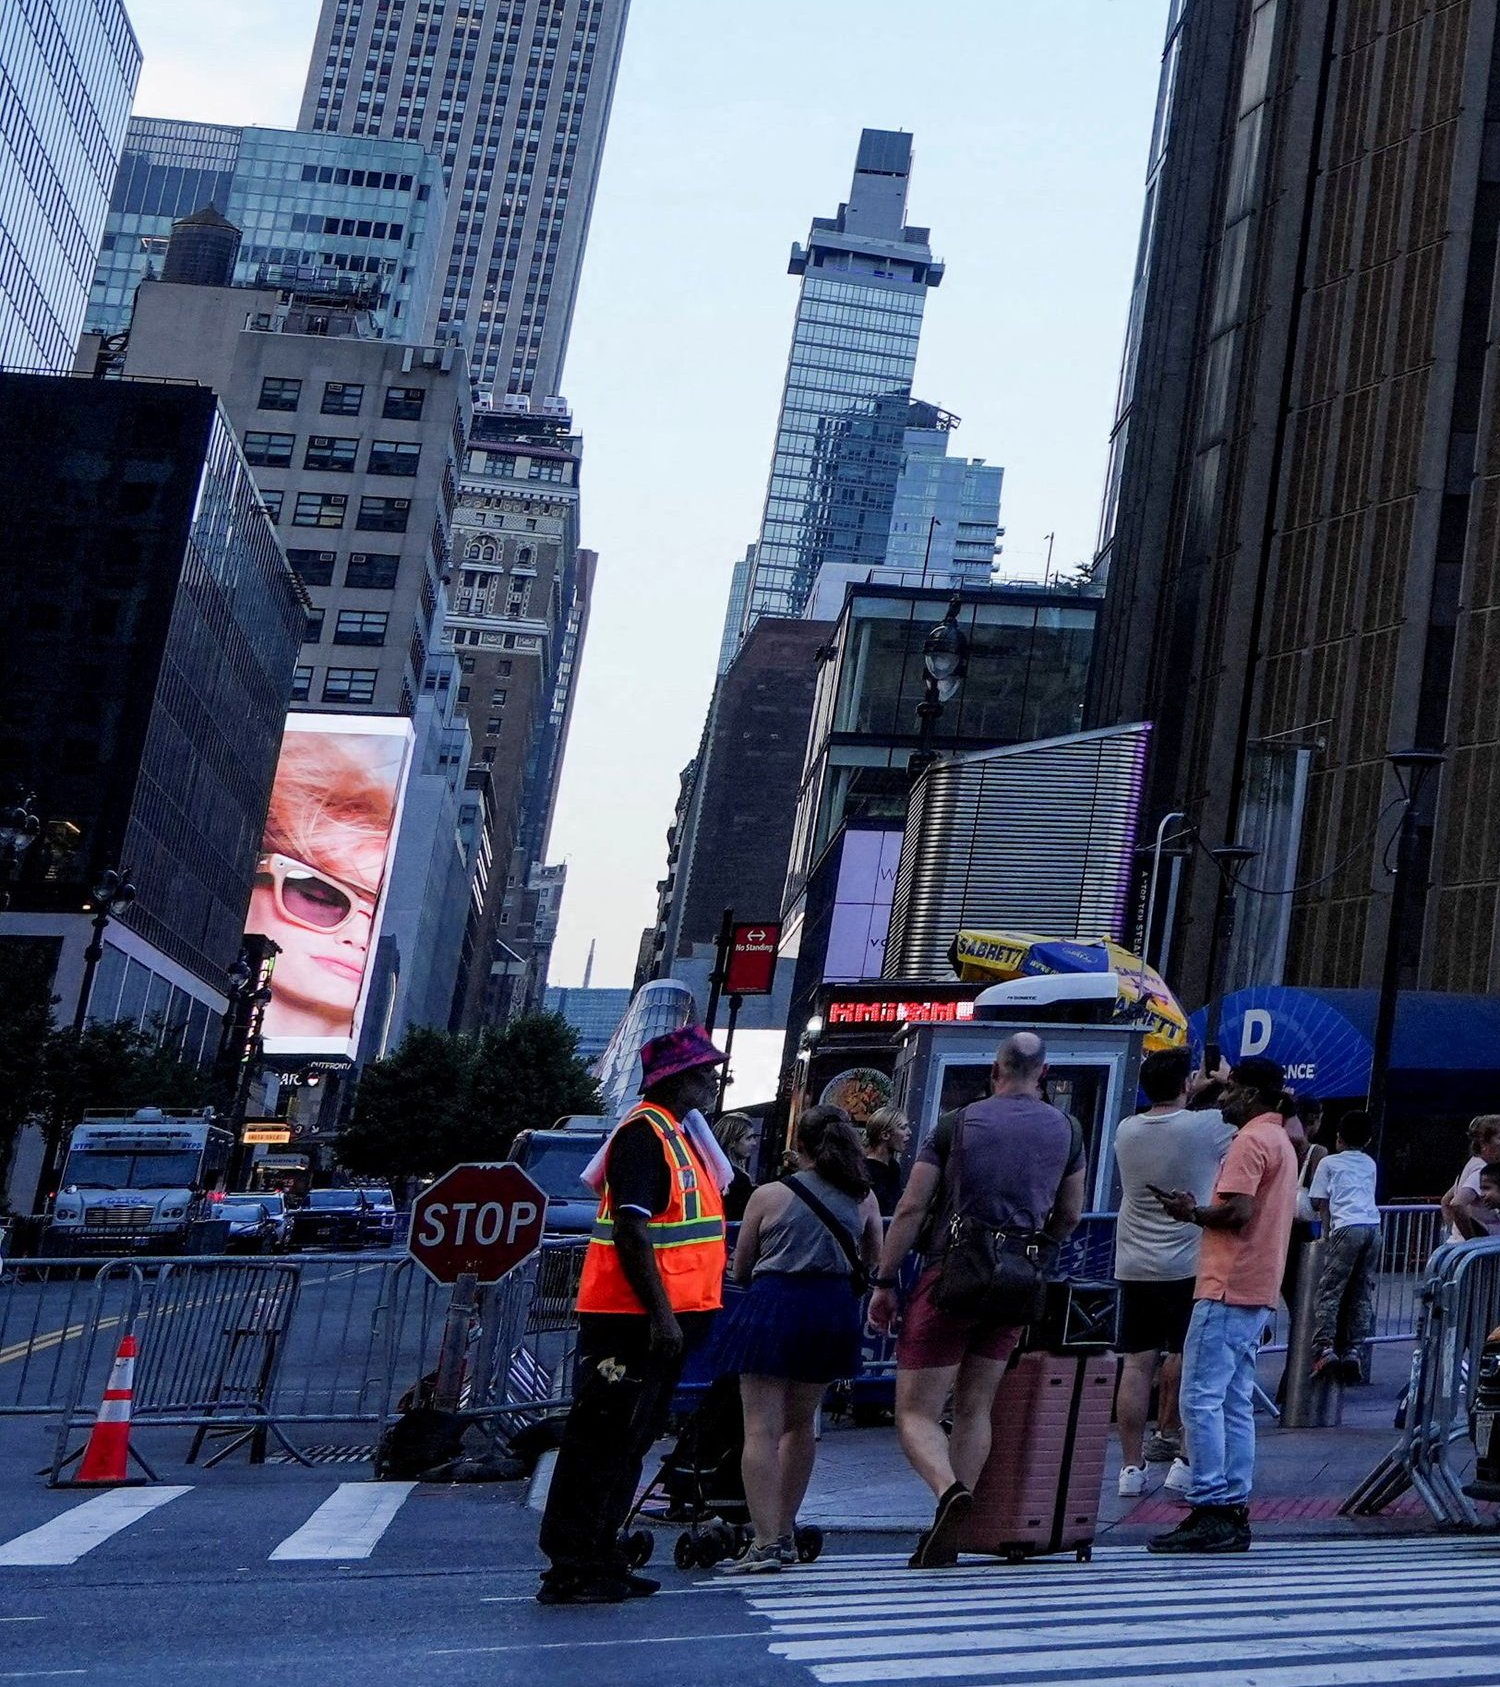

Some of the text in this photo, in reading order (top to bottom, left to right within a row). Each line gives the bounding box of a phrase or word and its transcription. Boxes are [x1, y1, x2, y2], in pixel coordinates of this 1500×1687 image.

[735, 943, 773, 953] No Standing
[1240, 1009, 1272, 1057] D
[418, 1202, 537, 1247] STOP
